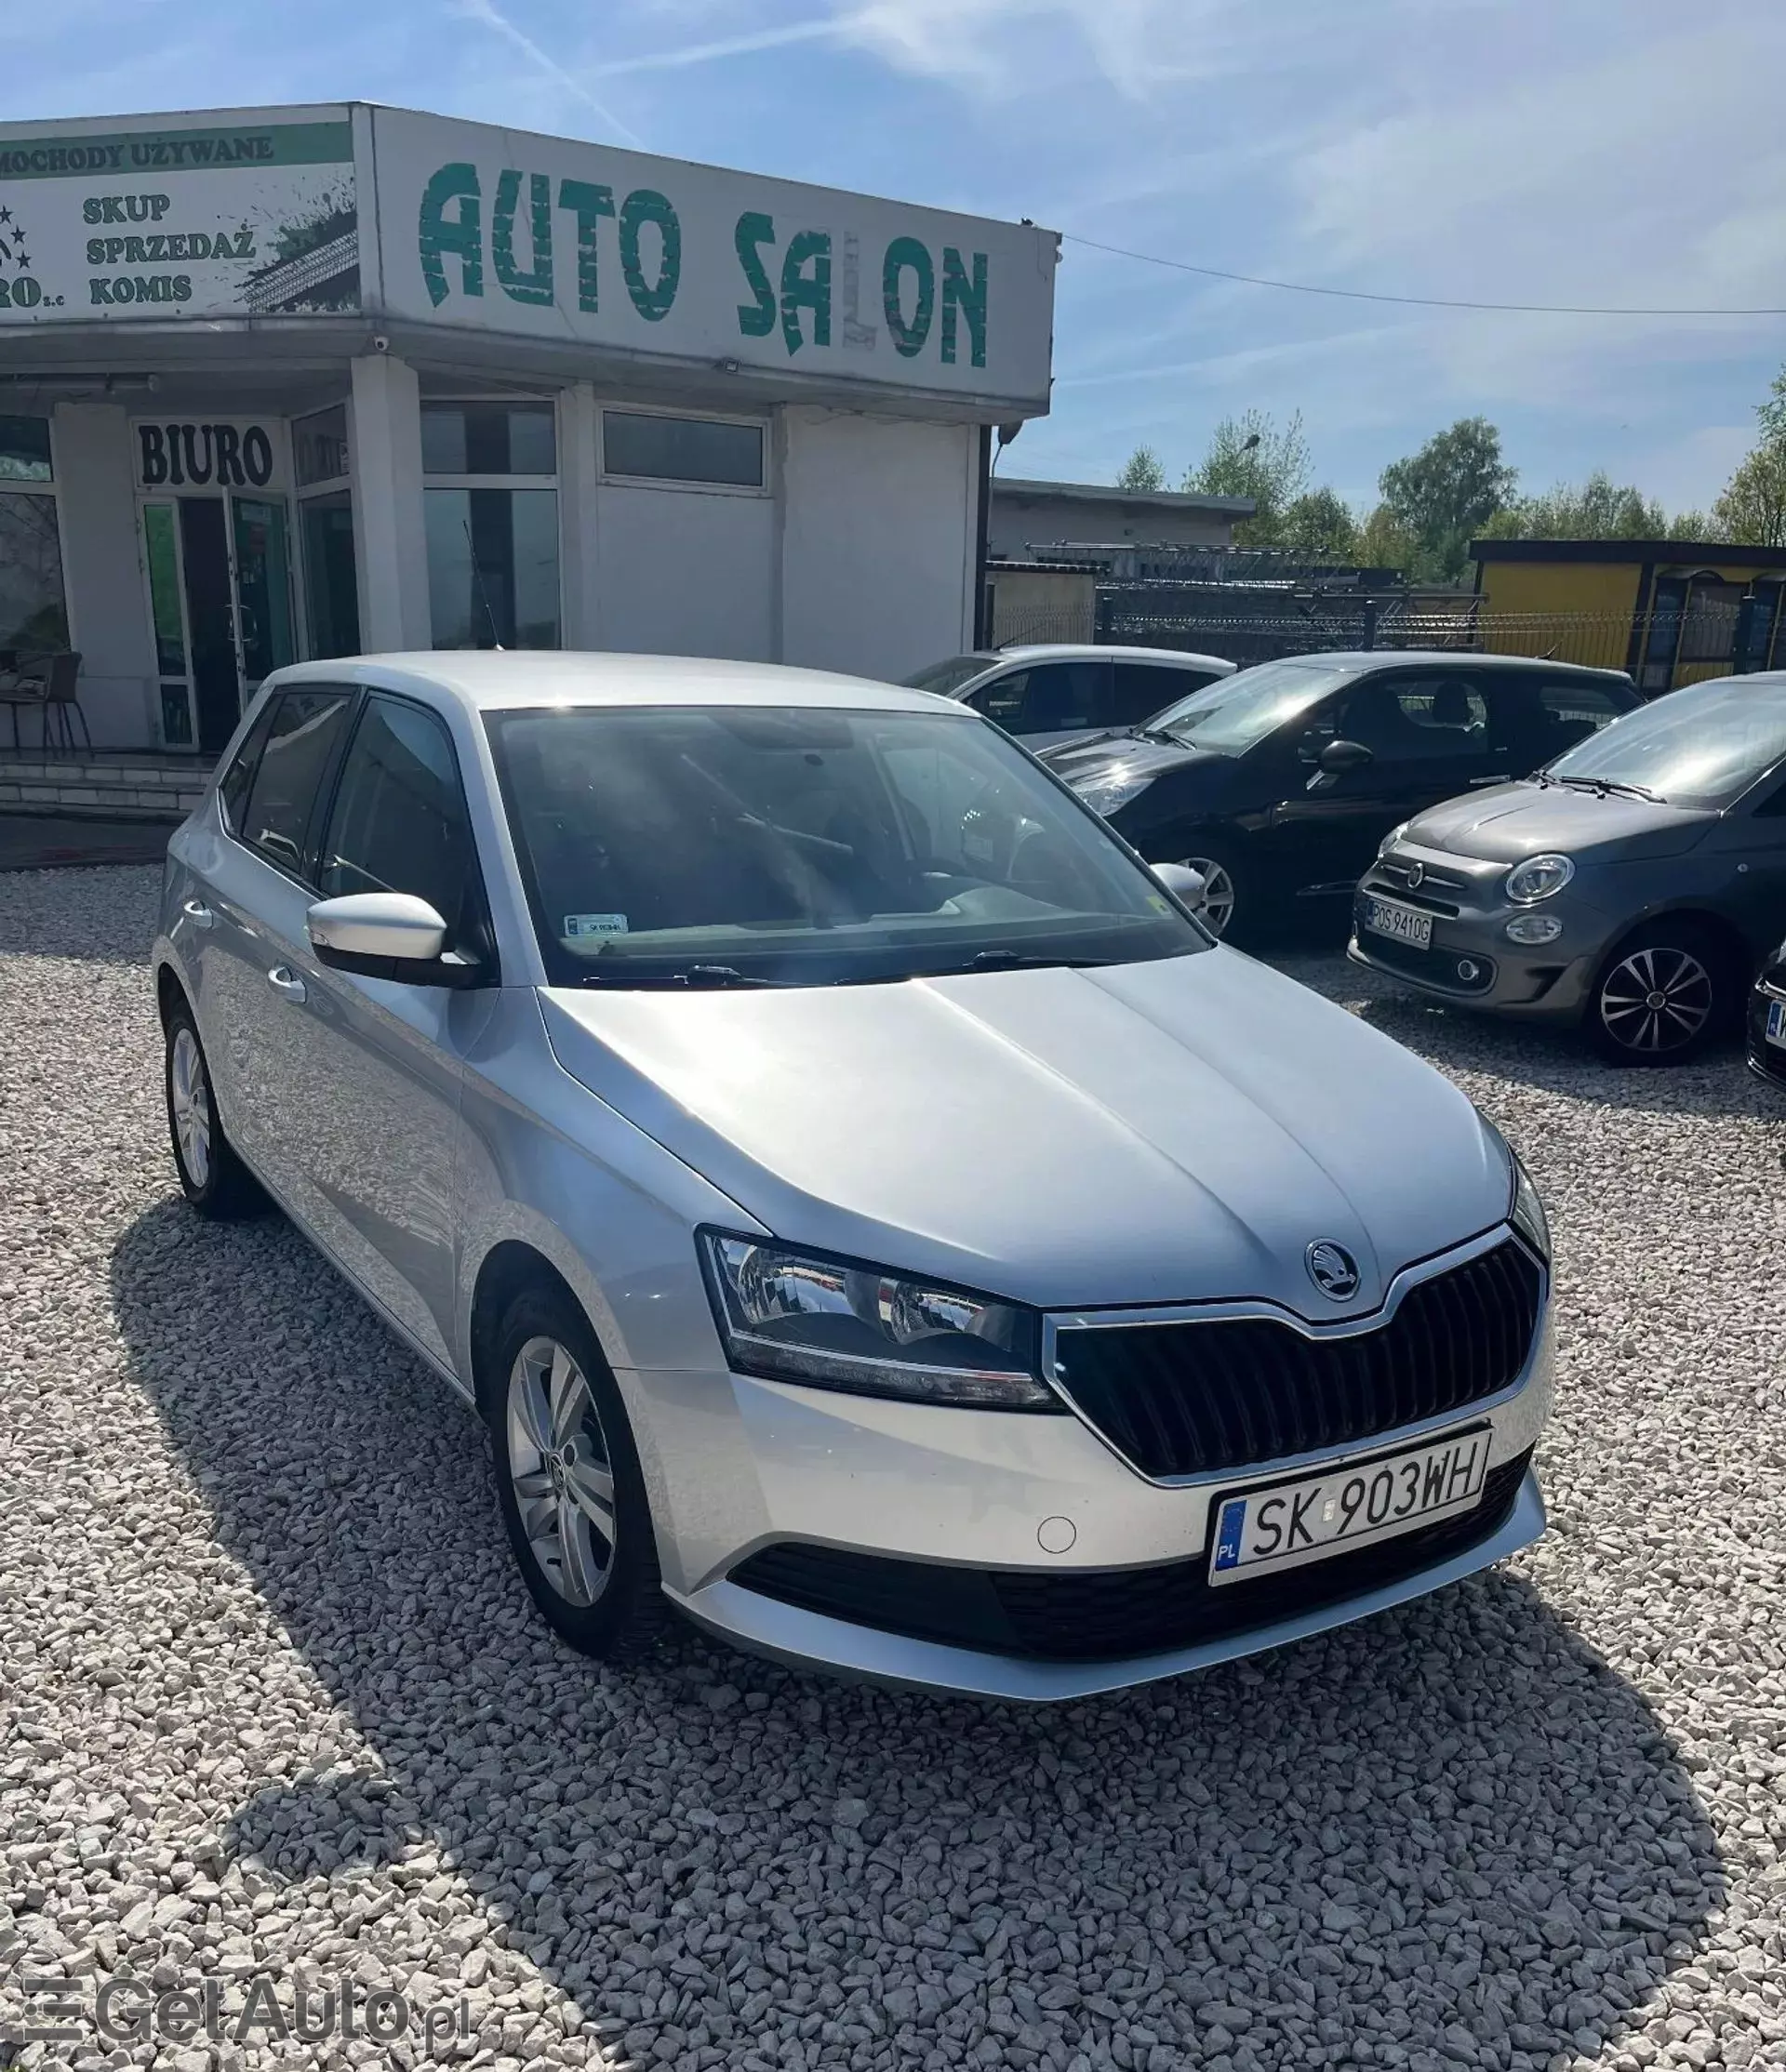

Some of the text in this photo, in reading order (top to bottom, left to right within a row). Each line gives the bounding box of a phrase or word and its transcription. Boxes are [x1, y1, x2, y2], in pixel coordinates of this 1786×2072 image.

[130, 136, 273, 166] UŻYWANE
[83, 193, 170, 224] SKUP
[87, 223, 256, 265] SPRZEDAŻ
[418, 162, 682, 323] AUTO
[90, 274, 193, 305] KOMIS
[139, 424, 273, 486] BIURO
[1373, 904, 1393, 930] POS
[1253, 1441, 1479, 1556] SK 903WH
[1218, 1545, 1236, 1559] PL
